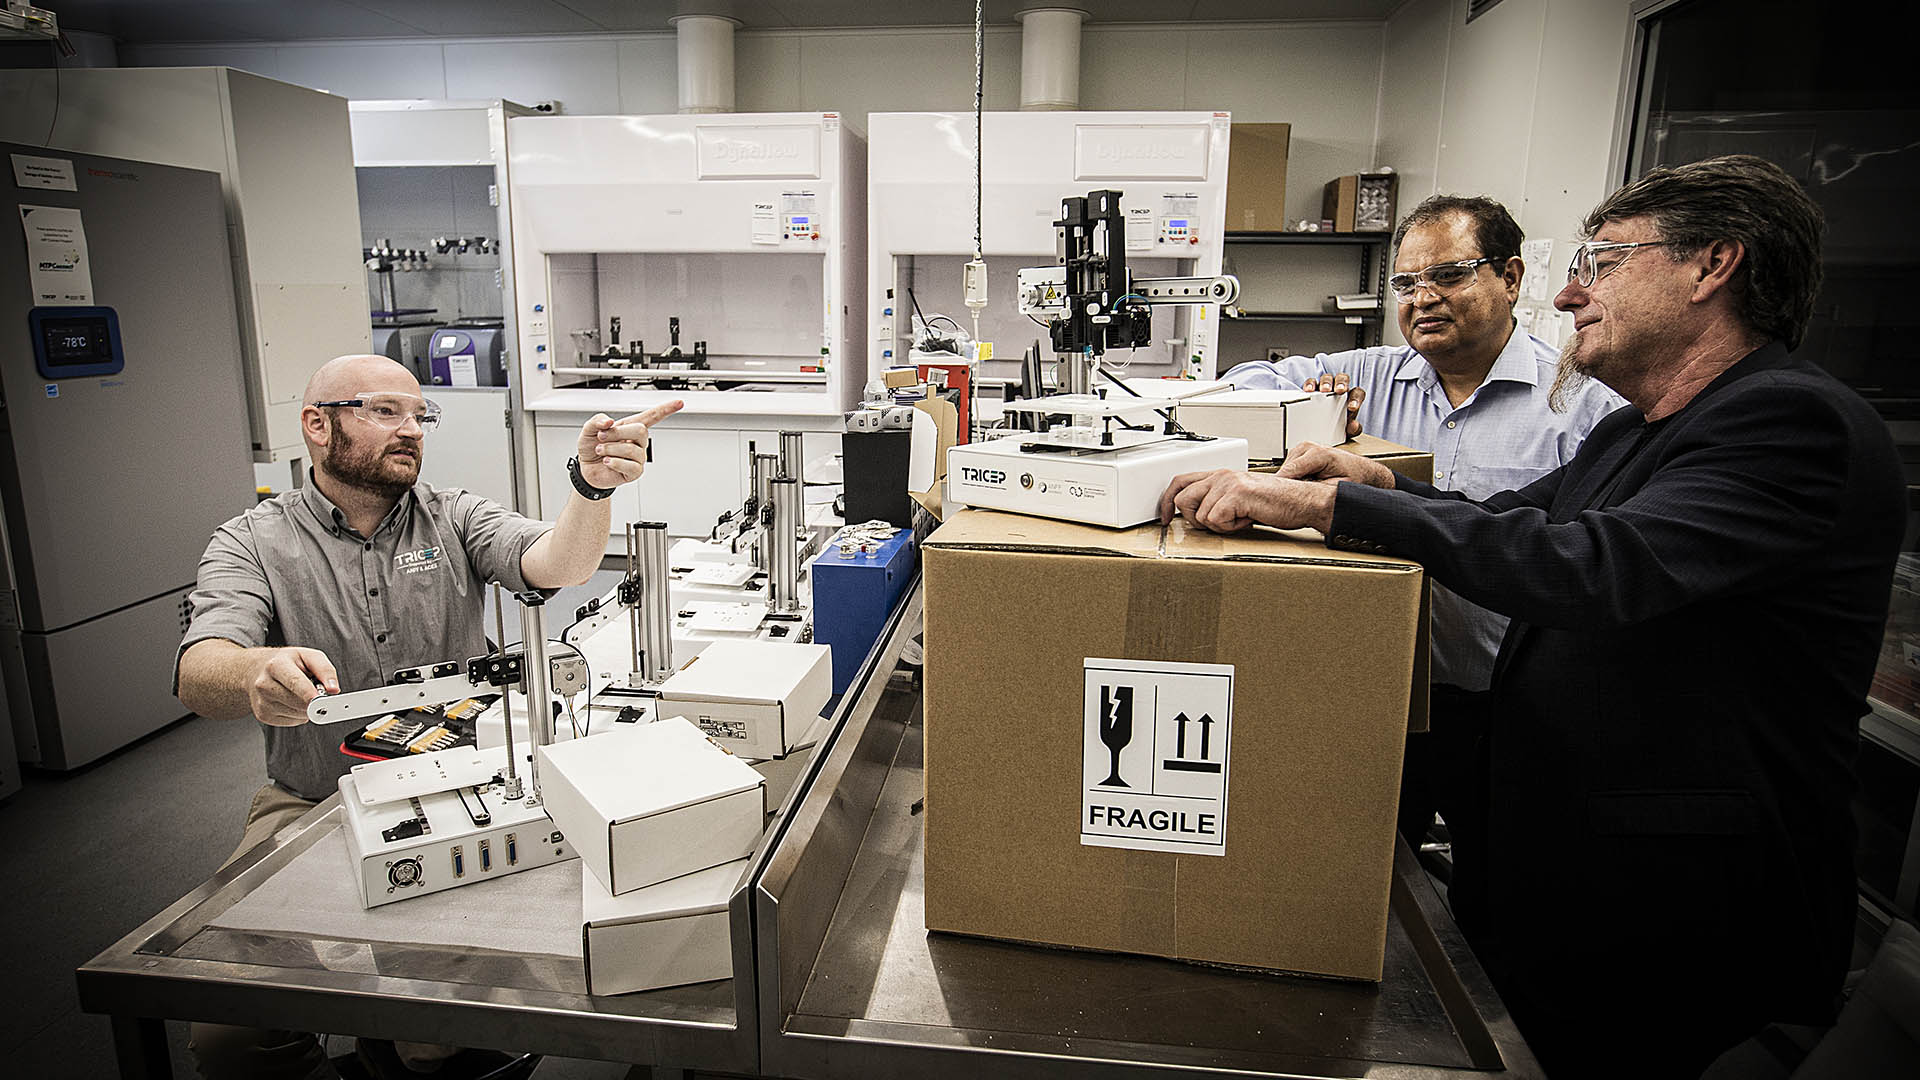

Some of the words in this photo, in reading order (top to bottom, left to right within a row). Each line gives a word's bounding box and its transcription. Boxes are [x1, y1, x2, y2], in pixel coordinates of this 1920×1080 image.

[962, 467, 1006, 484] TRICEP
[394, 546, 440, 565] TRICEP
[1089, 805, 1215, 834] FRAGILE
